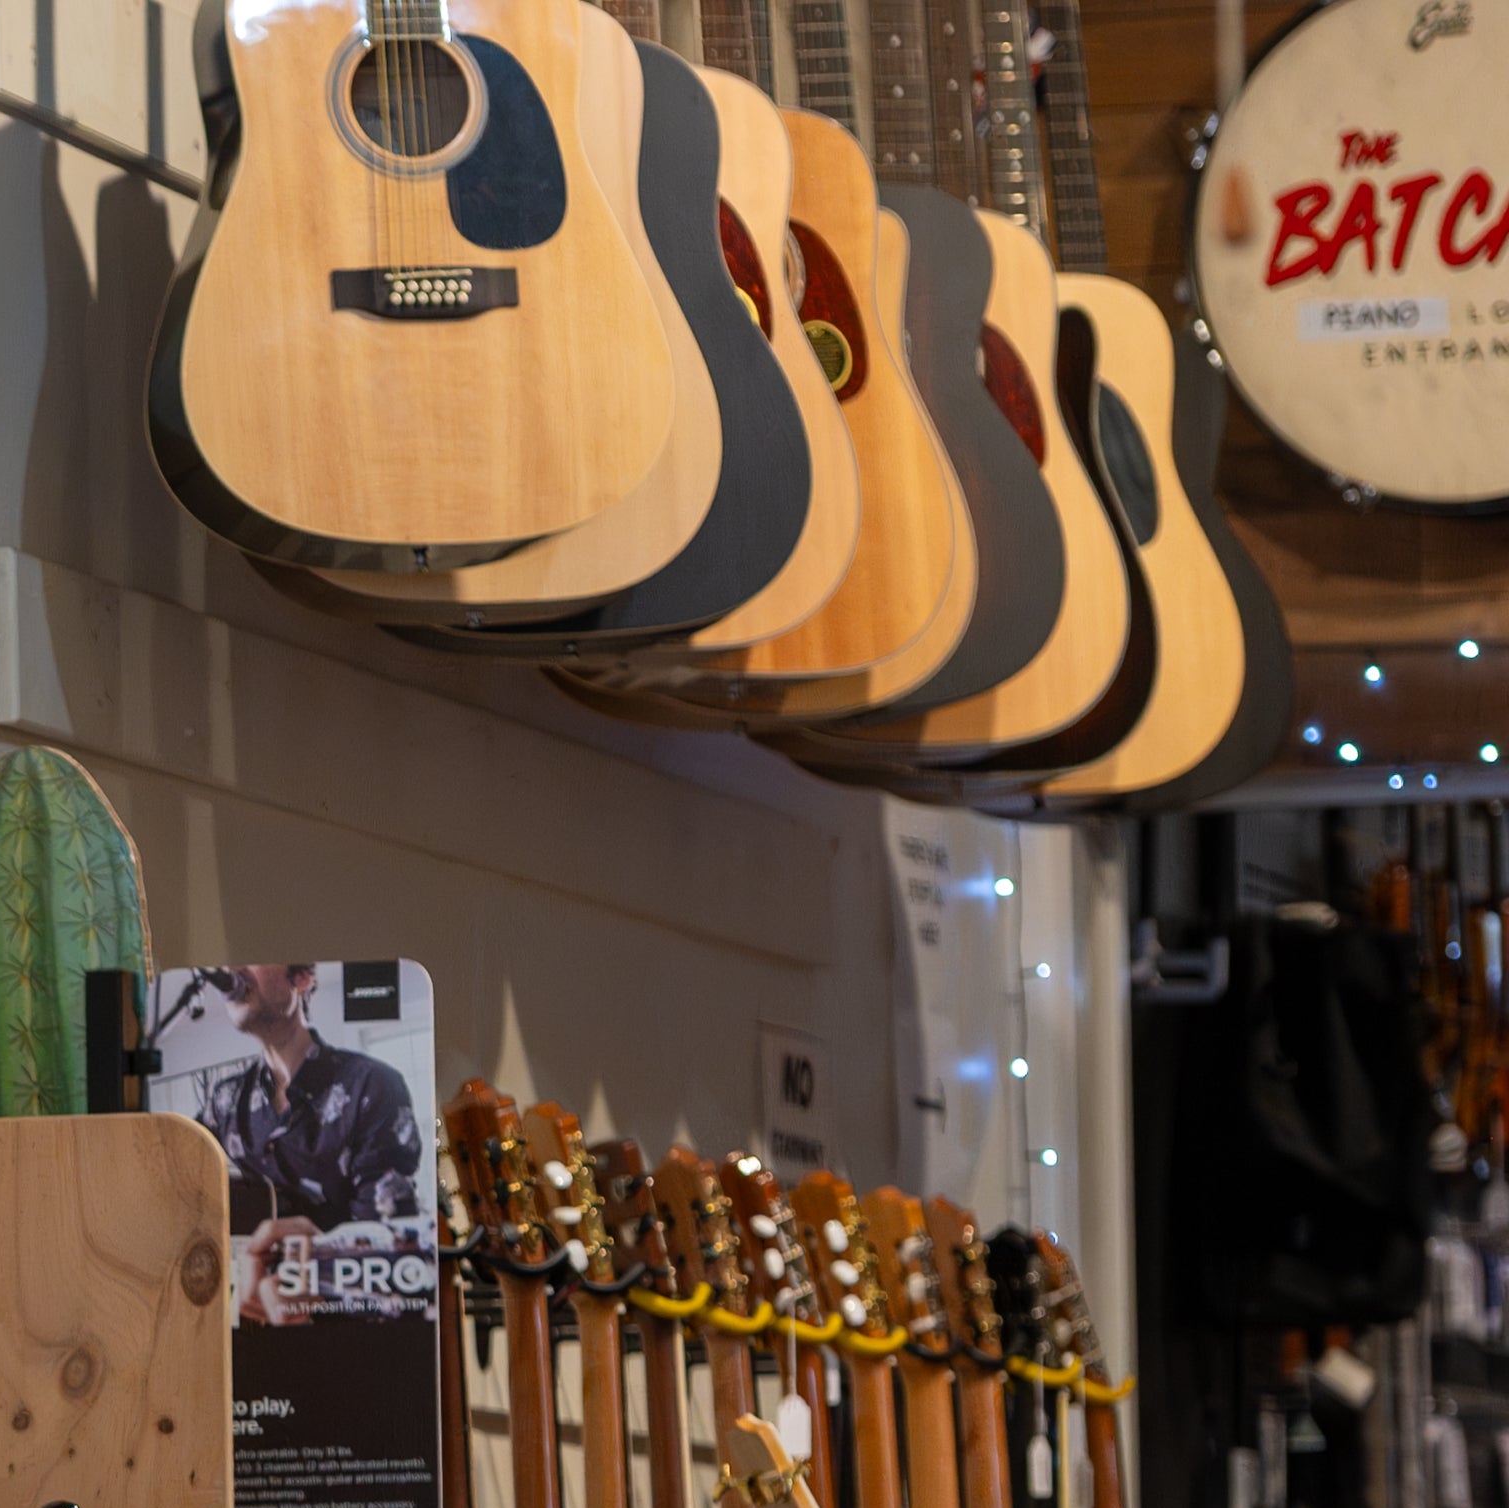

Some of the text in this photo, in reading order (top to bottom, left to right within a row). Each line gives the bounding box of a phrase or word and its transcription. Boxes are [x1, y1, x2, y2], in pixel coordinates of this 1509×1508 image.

[1338, 129, 1401, 171] THE
[1324, 301, 1421, 329] PIANO
[783, 1055, 813, 1109] NO
[277, 1254, 422, 1297] S1 PRO
[251, 1396, 295, 1418] play.
